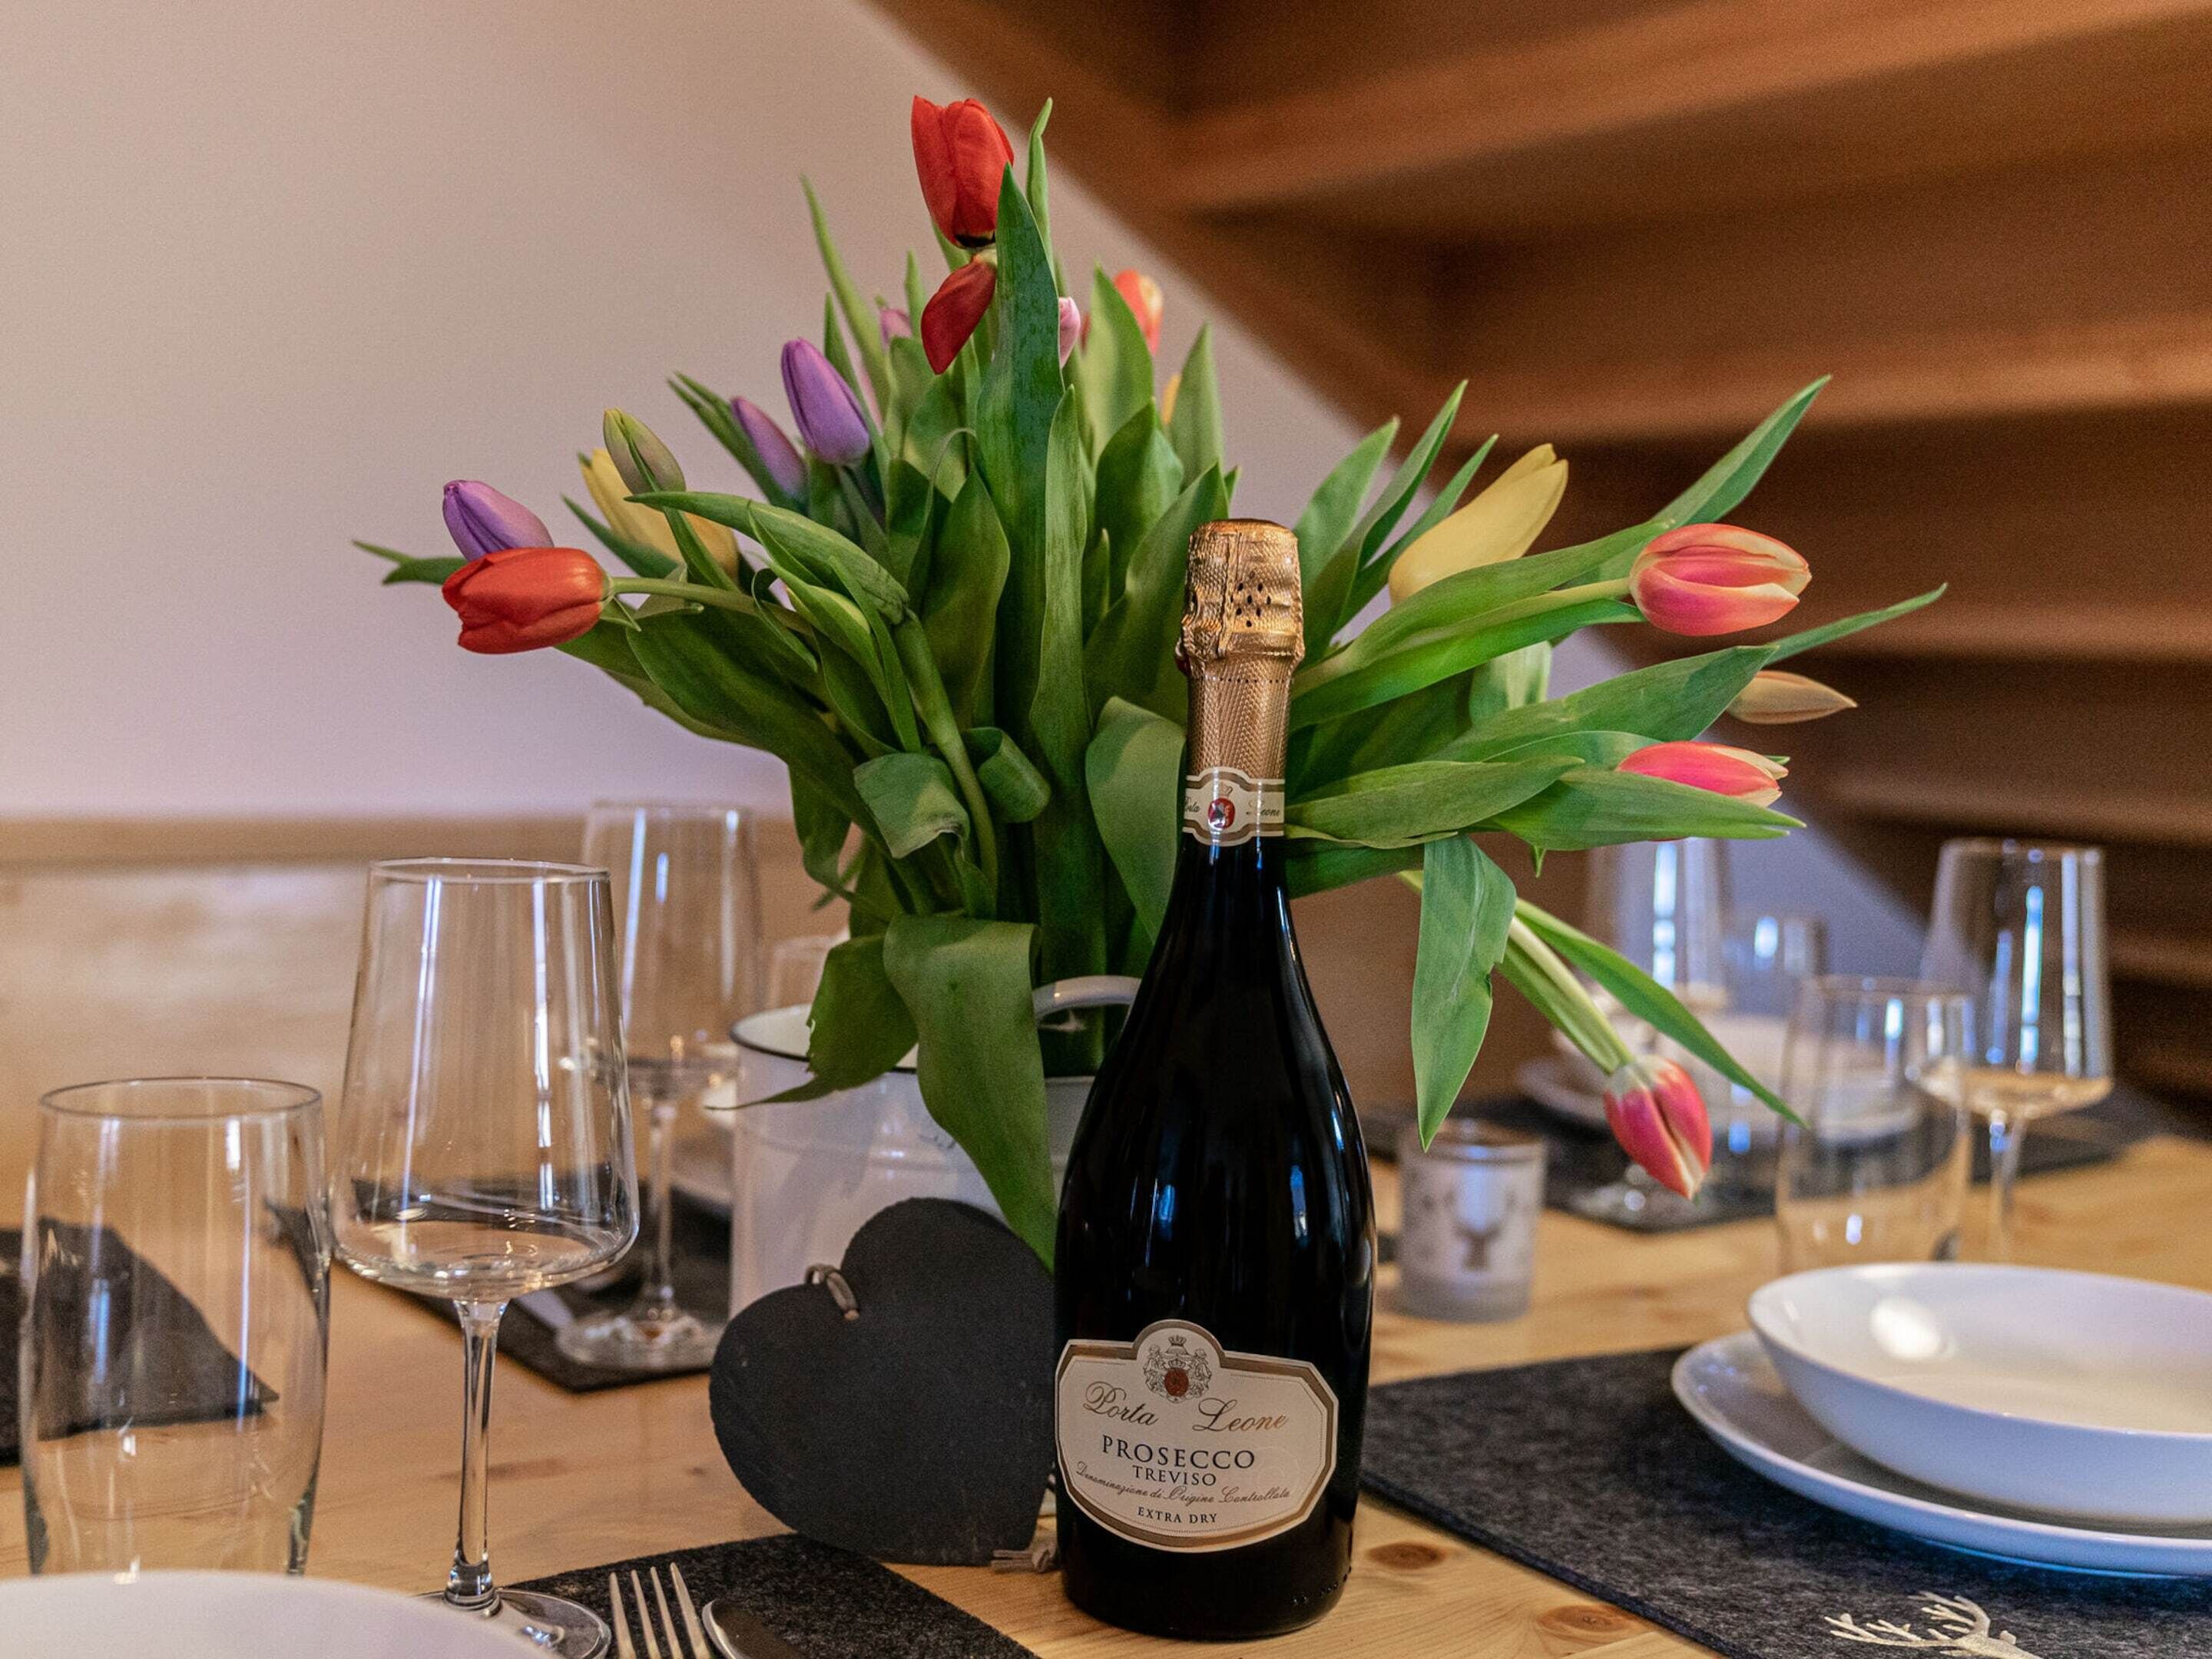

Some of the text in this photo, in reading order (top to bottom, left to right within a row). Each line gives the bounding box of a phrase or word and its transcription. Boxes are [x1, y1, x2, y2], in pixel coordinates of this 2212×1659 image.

[1084, 1381, 1287, 1432] Porta Leone
[1102, 1435, 1255, 1469] PROSECCO
[1075, 1461, 1290, 1506] Denominazione di Origine Controllata
[1132, 1465, 1217, 1486] TREVISO
[1137, 1507, 1217, 1524] EXTRA DRY
